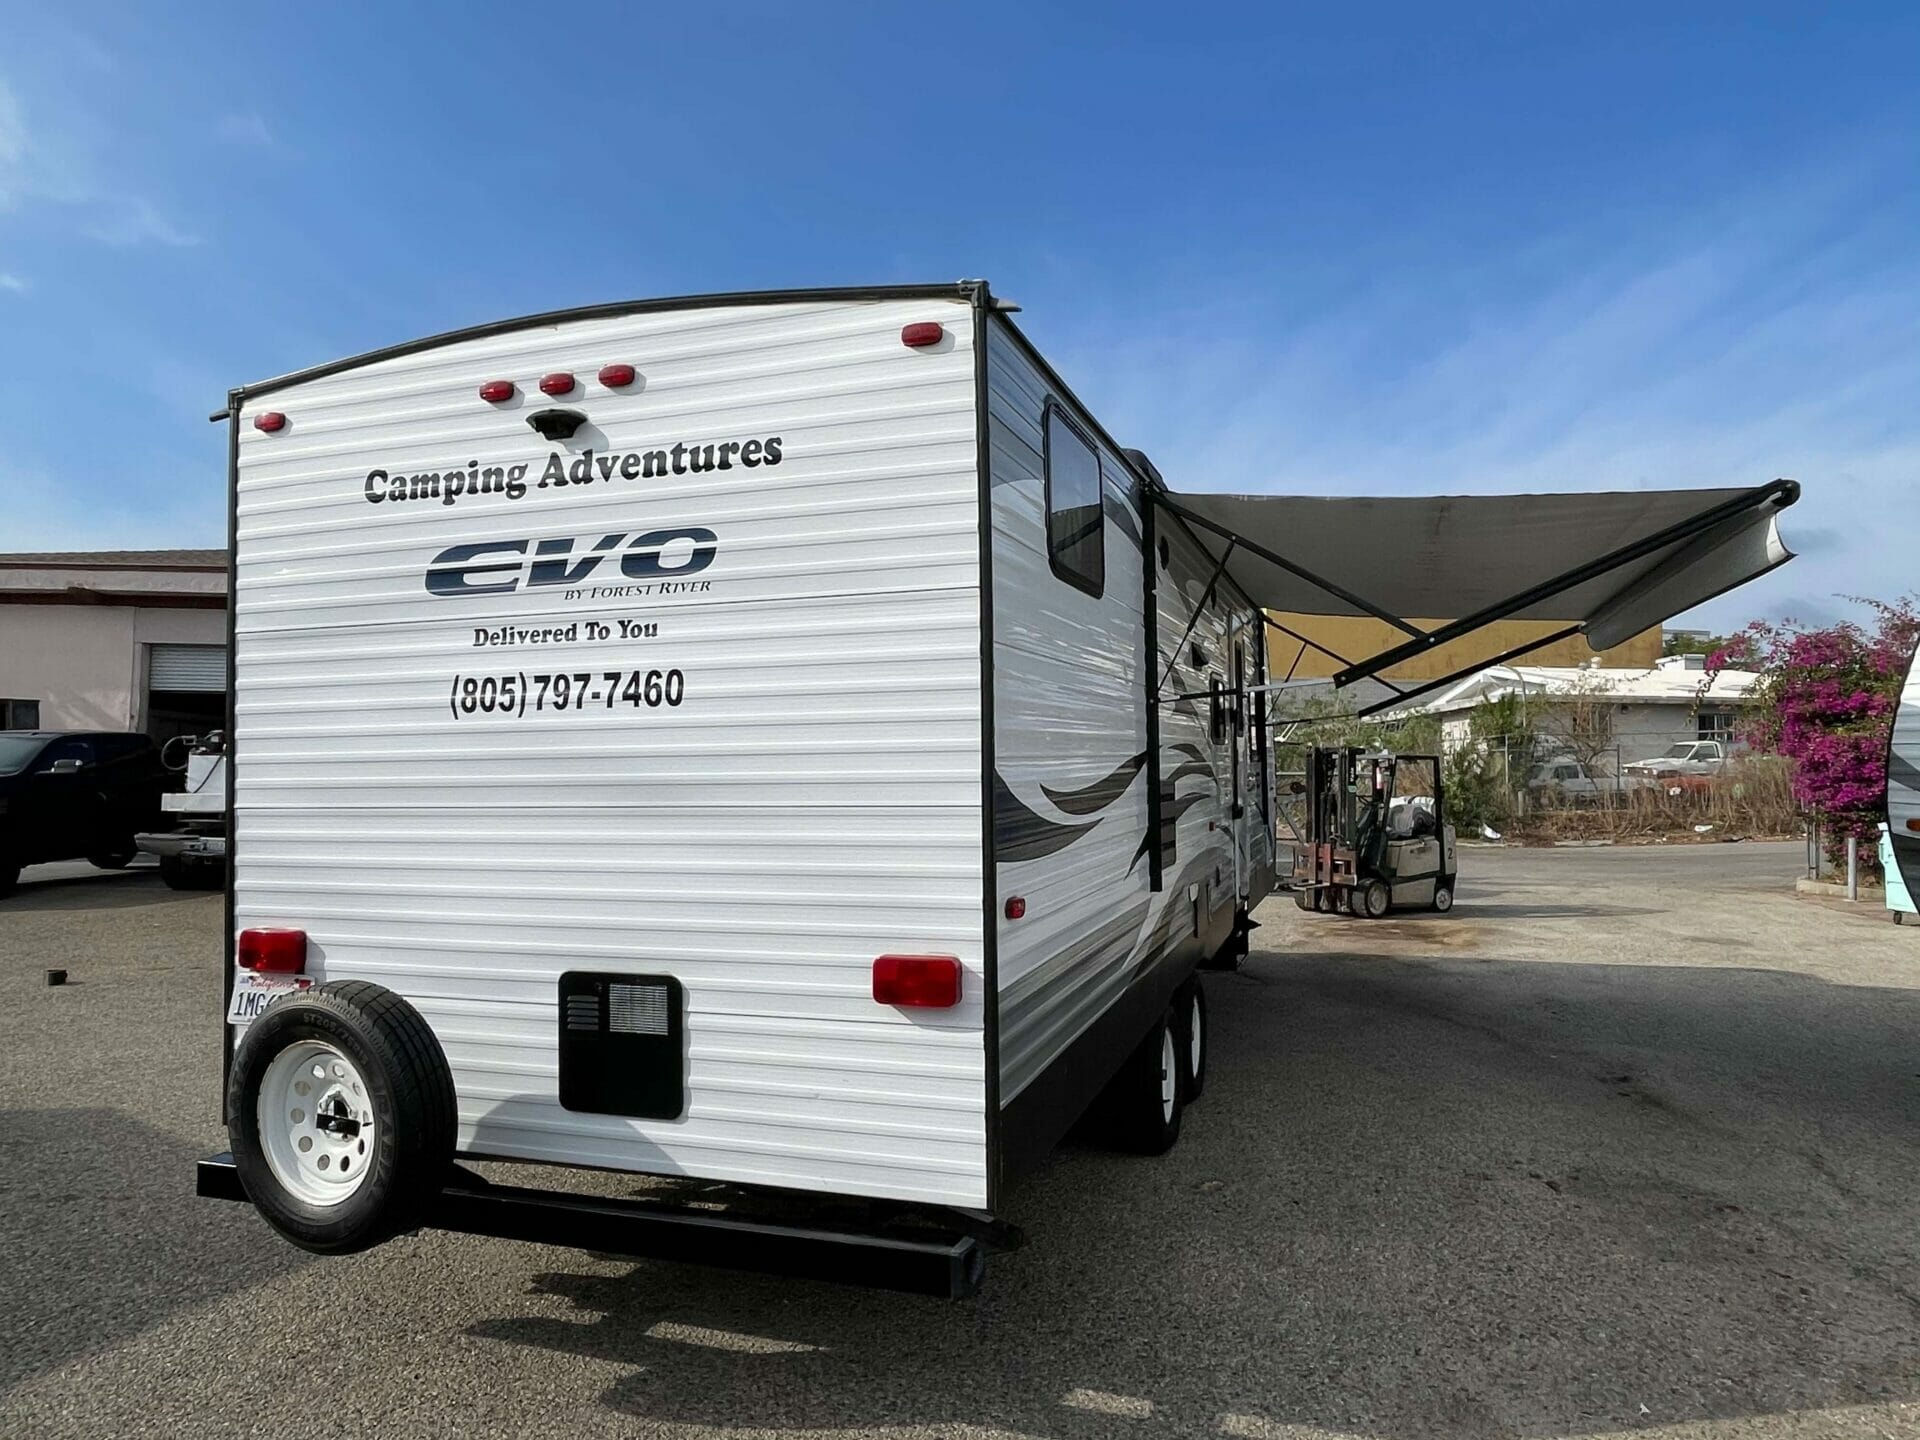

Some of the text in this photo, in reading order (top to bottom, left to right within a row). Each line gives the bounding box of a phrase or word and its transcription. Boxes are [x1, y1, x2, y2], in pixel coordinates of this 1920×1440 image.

[364, 437, 783, 505] Camping Adventures
[424, 527, 718, 596] EVO
[564, 589, 586, 600] BY
[473, 619, 659, 647] Delivered To You
[533, 668, 685, 711] 797-7460
